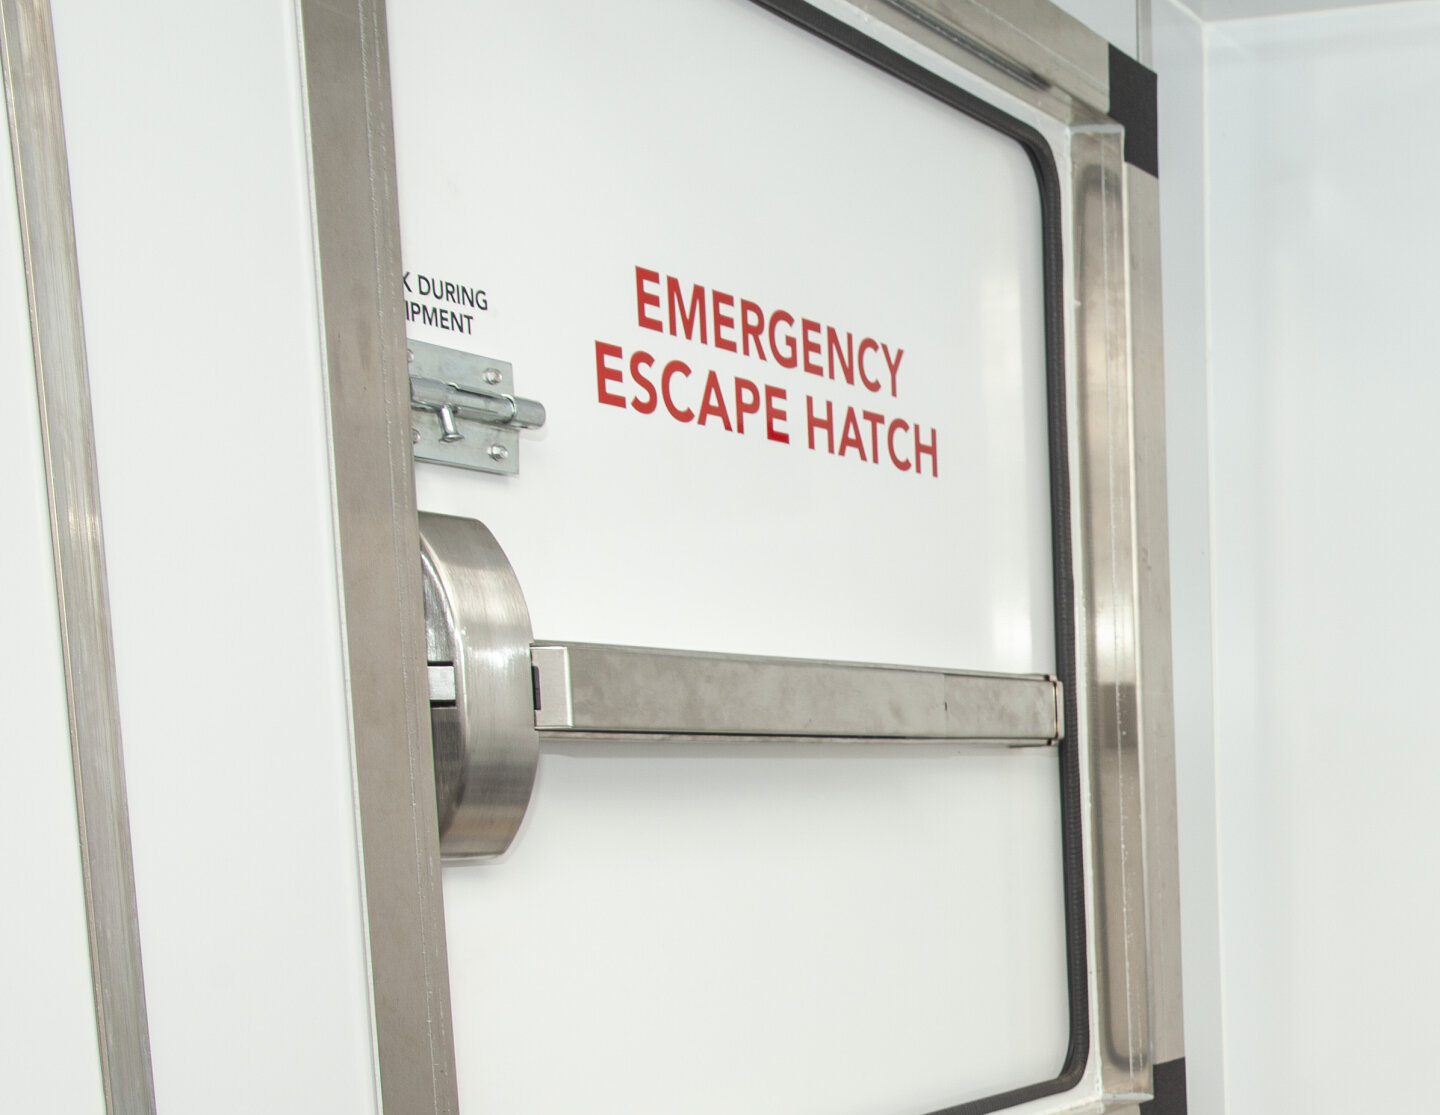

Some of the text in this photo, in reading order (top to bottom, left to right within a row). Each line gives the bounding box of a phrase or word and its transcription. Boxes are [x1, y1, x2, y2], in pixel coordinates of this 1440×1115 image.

[417, 273, 488, 311] DURING
[634, 265, 904, 398] EMERGENCY
[594, 339, 939, 478] ESCAPE HATCH
